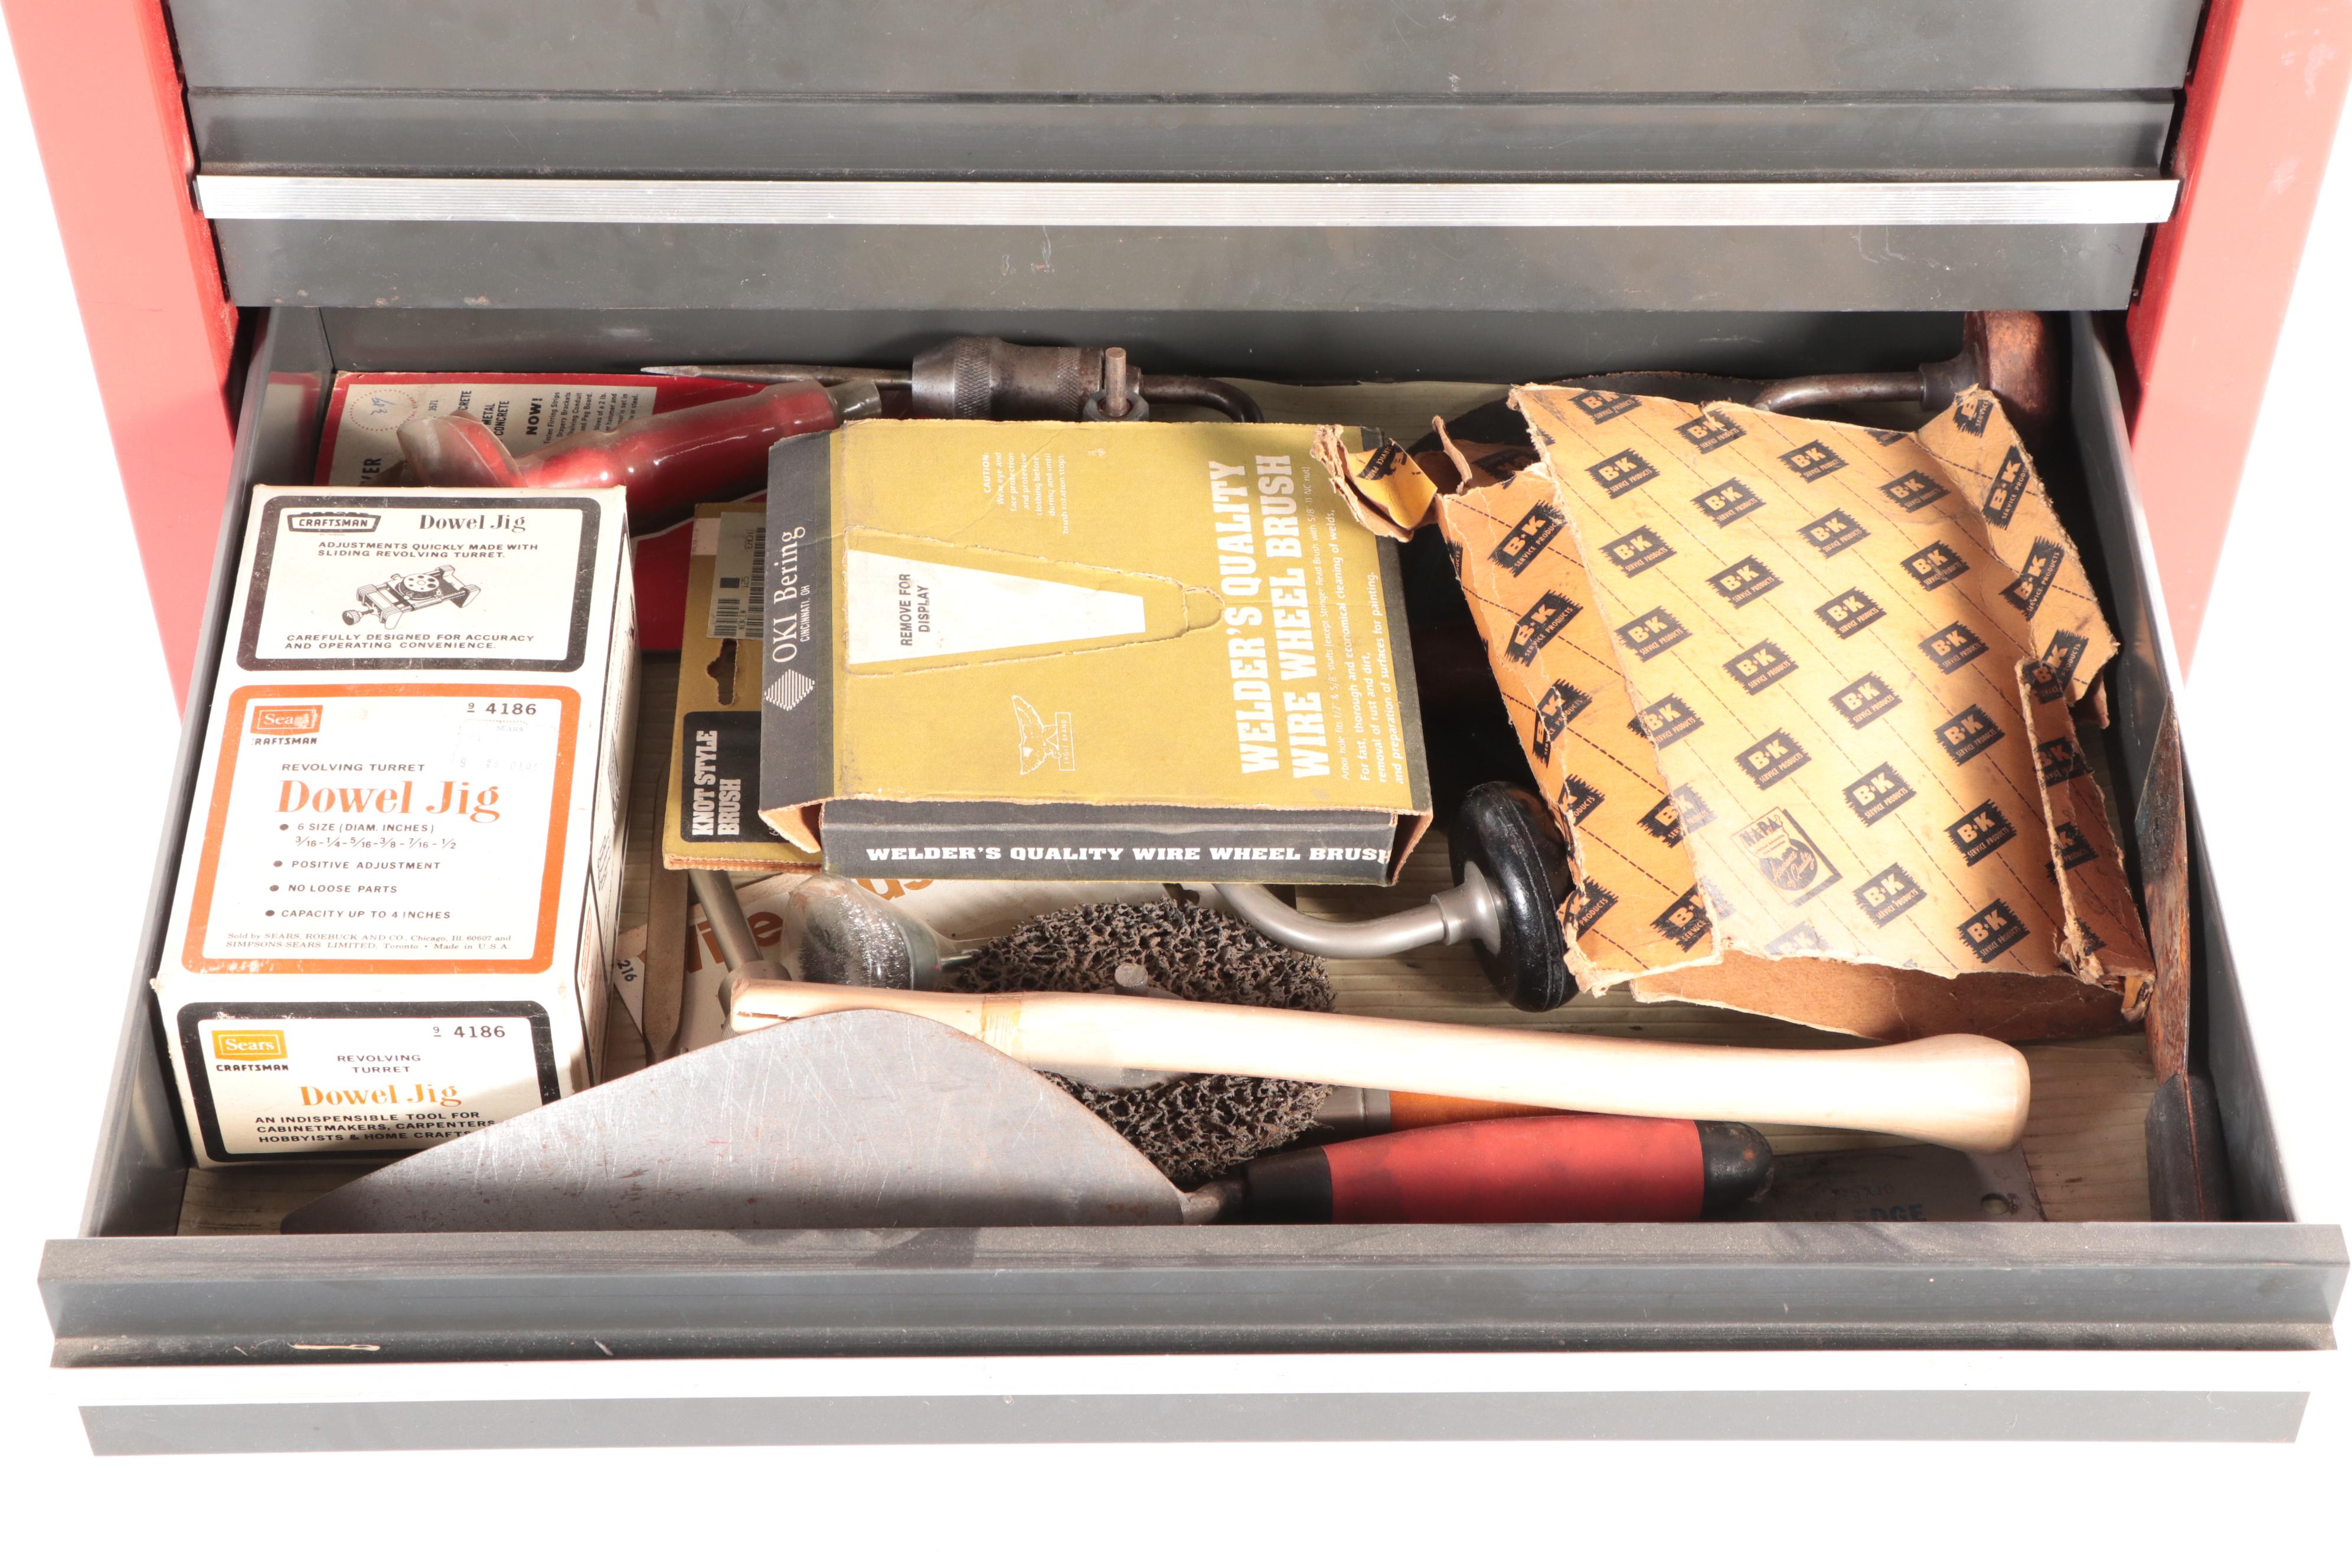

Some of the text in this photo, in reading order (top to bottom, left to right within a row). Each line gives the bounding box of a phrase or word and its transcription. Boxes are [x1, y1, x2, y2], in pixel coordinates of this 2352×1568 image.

[551, 392, 560, 408] Strips
[561, 392, 571, 416] Brackets
[572, 393, 582, 414] Conduit
[482, 404, 495, 425] METAL
[494, 401, 509, 436] CONCRETE
[526, 398, 543, 436] NOW!
[299, 518, 368, 527] CRAFTSMAN
[419, 514, 526, 533] Dowel Jig
[1308, 525, 1318, 541] with
[318, 541, 409, 550] ADJUSTMENTS
[412, 543, 465, 551] QUICKLY
[1311, 543, 1322, 565] Brush
[773, 526, 806, 663] OKI Bering
[801, 584, 811, 596] OH
[899, 574, 913, 646] REMOVE FOR
[917, 585, 930, 633] DISPLAY
[1317, 587, 1328, 618] Stringer
[1208, 460, 1280, 774] WELDER'S QUALITY
[1255, 455, 1331, 779] WIRE WHEEL BRUSH
[1524, 606, 1573, 657] SERVICE PRODUCTS
[1324, 509, 1371, 781] For fast, thorough and economical cleaning of welds,
[1325, 649, 1335, 671] shafts
[1367, 570, 1404, 785] and preparation of surfaces for painting.
[1747, 659, 1791, 689] SERVICE PRODUCTS
[485, 703, 537, 716] 4186
[1360, 651, 1387, 783] removal of rust and dirt,
[1853, 694, 1894, 723] SERVICE PRODUCTS
[251, 737, 318, 746] RAFTSMAN
[1338, 736, 1346, 753] hole
[282, 763, 426, 772] REVOLVING TURRET
[1341, 756, 1351, 780] Arbor
[1759, 752, 1804, 784] SERVICE PRODUCTS
[692, 730, 718, 837] KNOT STYLE
[275, 780, 502, 824] Dowel Jig
[717, 778, 741, 837] BRUSH
[1864, 788, 1909, 819] SERVICE PRODUCTS
[297, 822, 435, 834] 6 SIZE (DIAM. INCHES)
[291, 860, 441, 870] POSITIVE ADJUSTMENT
[866, 847, 1392, 865] WELDER'S QUALITY WIRE WHEEL BRUSH
[288, 884, 398, 894] NO LOOSE PARTS
[281, 910, 451, 920] CAPACITY UP TO 4 INCHES
[249, 932, 261, 941] by
[618, 959, 638, 982] 216
[453, 1025, 506, 1039] 4186
[225, 1038, 275, 1052] Sears
[215, 1064, 289, 1072] CRAFTSMAN
[337, 1054, 422, 1063] REVOLVING
[351, 1065, 411, 1074] TURRET
[298, 1083, 463, 1108] Dowel Jig
[255, 1116, 276, 1124] AN
[280, 1114, 398, 1124] INDISPENSIBLE
[406, 1112, 447, 1121] TOOL
[256, 1123, 391, 1133] CABINETMAKERS,
[259, 1133, 344, 1143] HOBBYISTS
[349, 1133, 360, 1141] &
[364, 1132, 408, 1141] HOME
